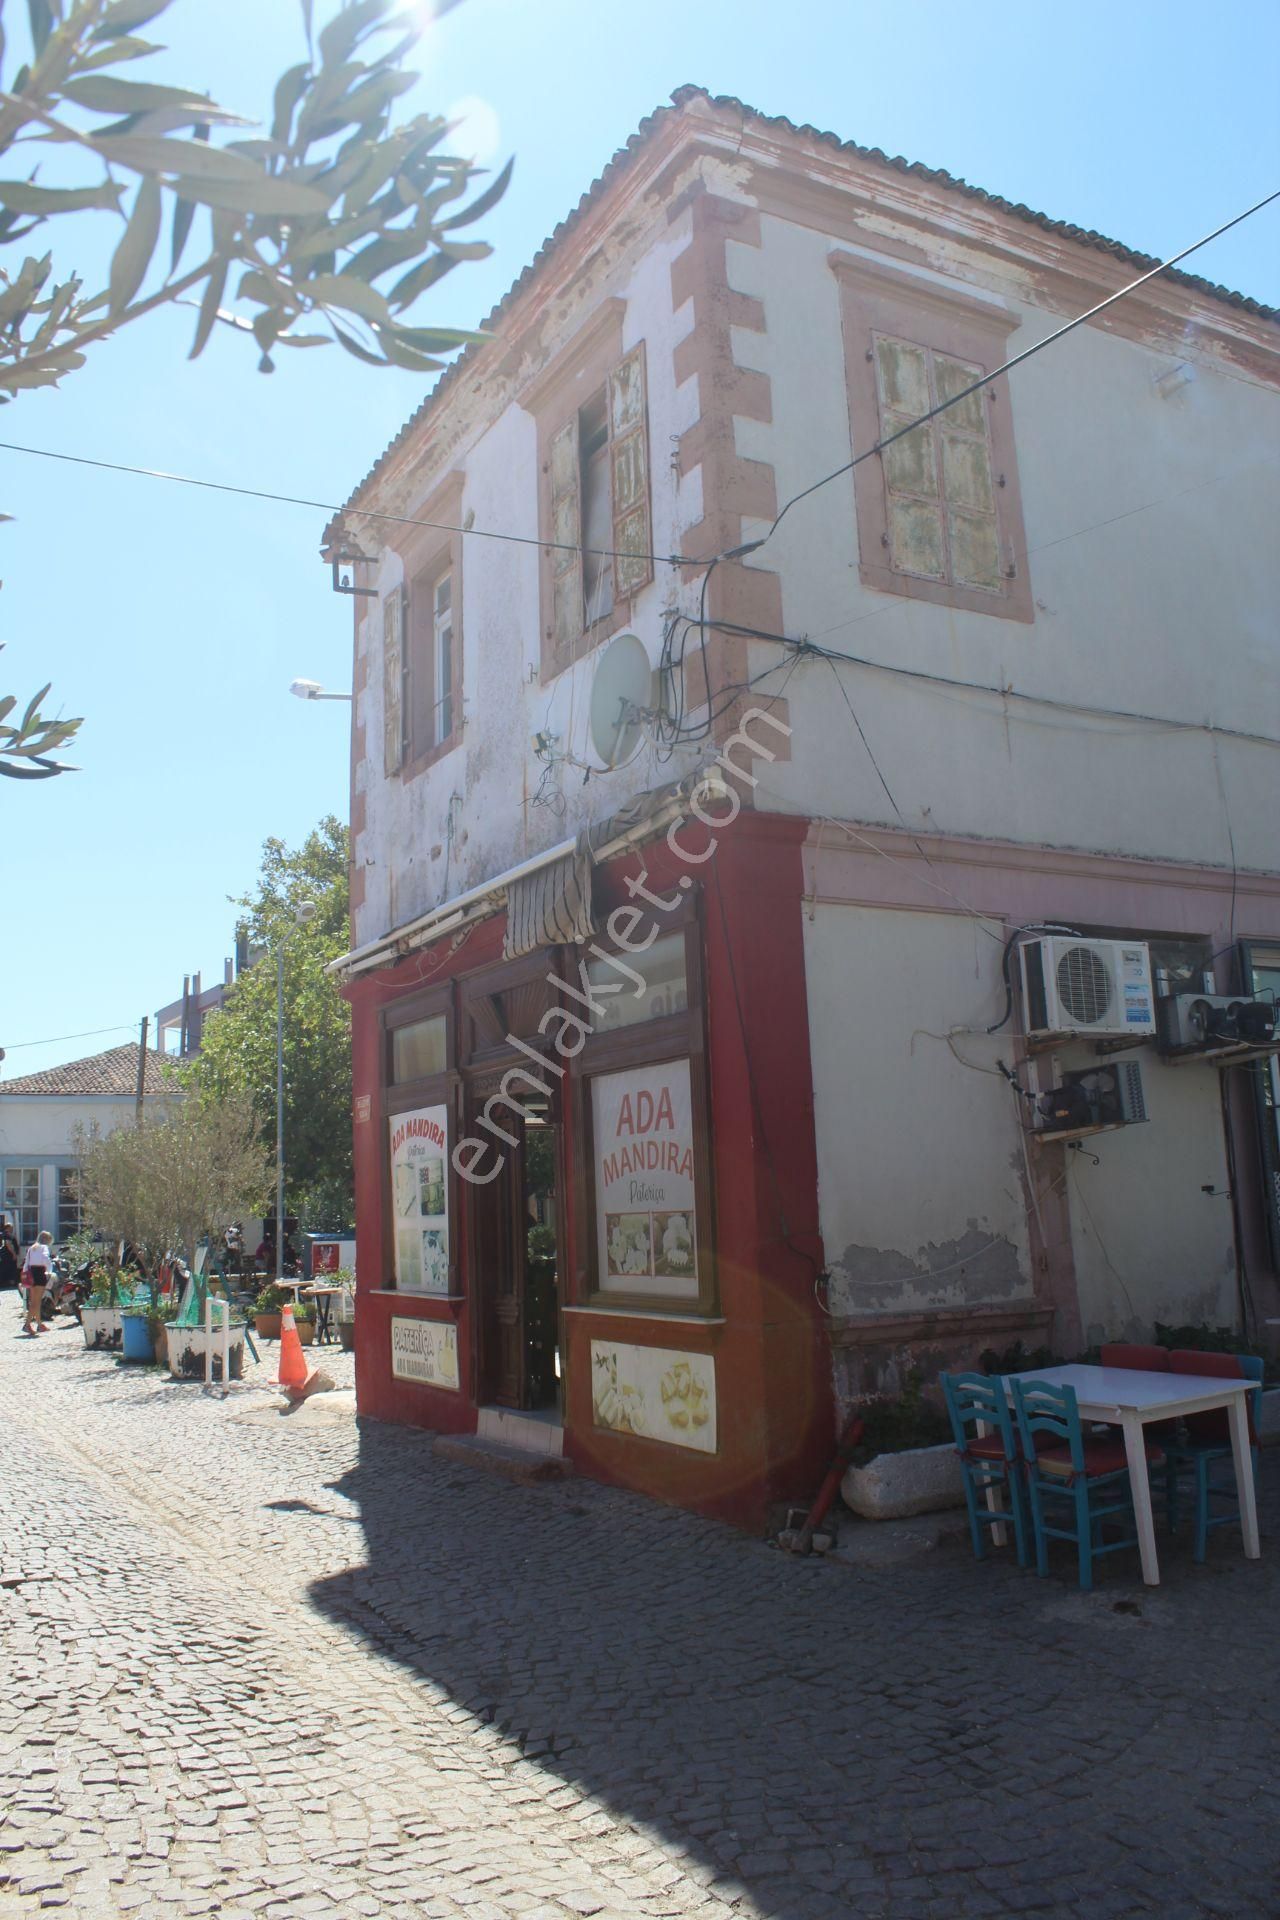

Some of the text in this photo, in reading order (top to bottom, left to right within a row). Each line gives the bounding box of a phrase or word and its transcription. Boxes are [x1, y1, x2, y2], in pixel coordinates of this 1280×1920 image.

[616, 1086, 675, 1137] ADA
[392, 1118, 445, 1156] ADA MANDIRA
[602, 1140, 694, 1188] MANDIRA
